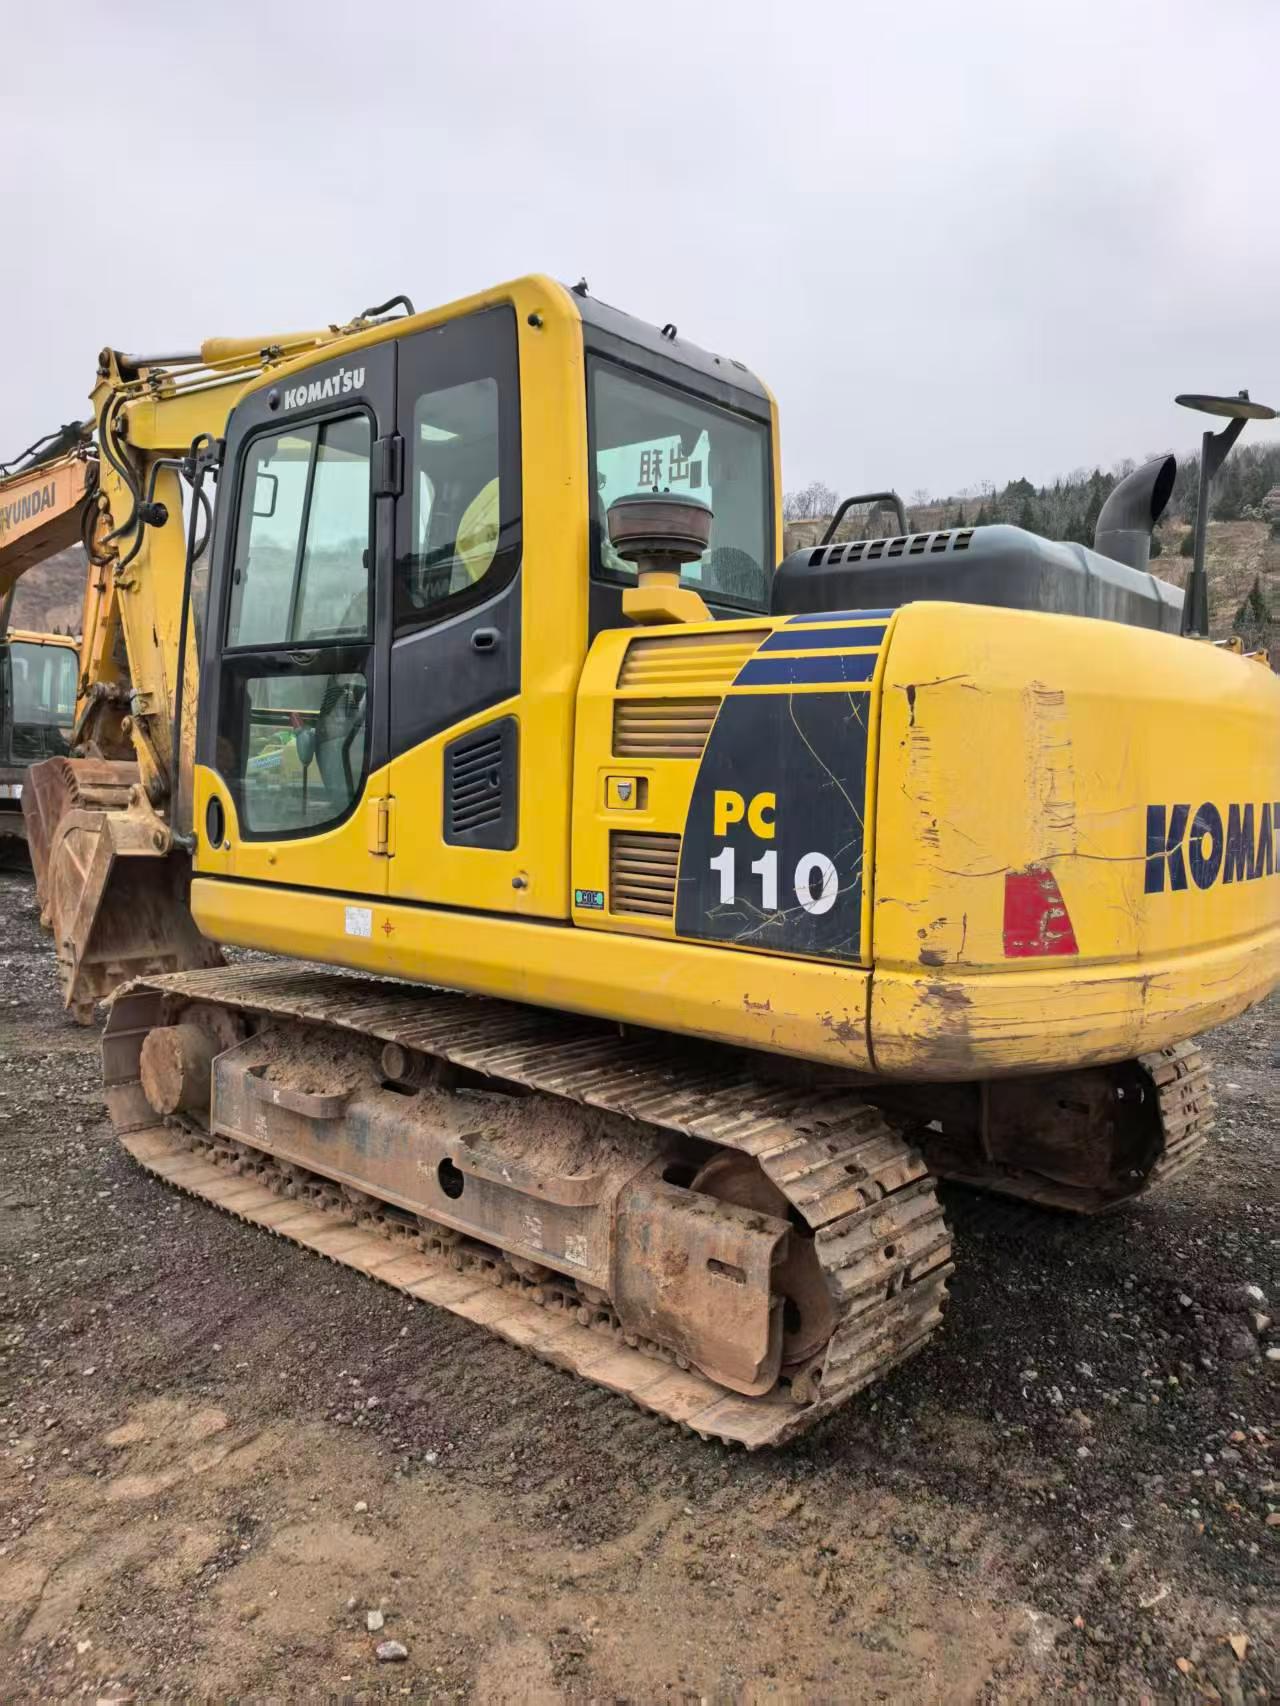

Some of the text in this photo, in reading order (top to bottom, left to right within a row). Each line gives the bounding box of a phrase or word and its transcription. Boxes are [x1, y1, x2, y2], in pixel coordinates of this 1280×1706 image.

[284, 367, 365, 410] KOMATSU
[714, 790, 776, 839] PC
[710, 847, 838, 915] 110
